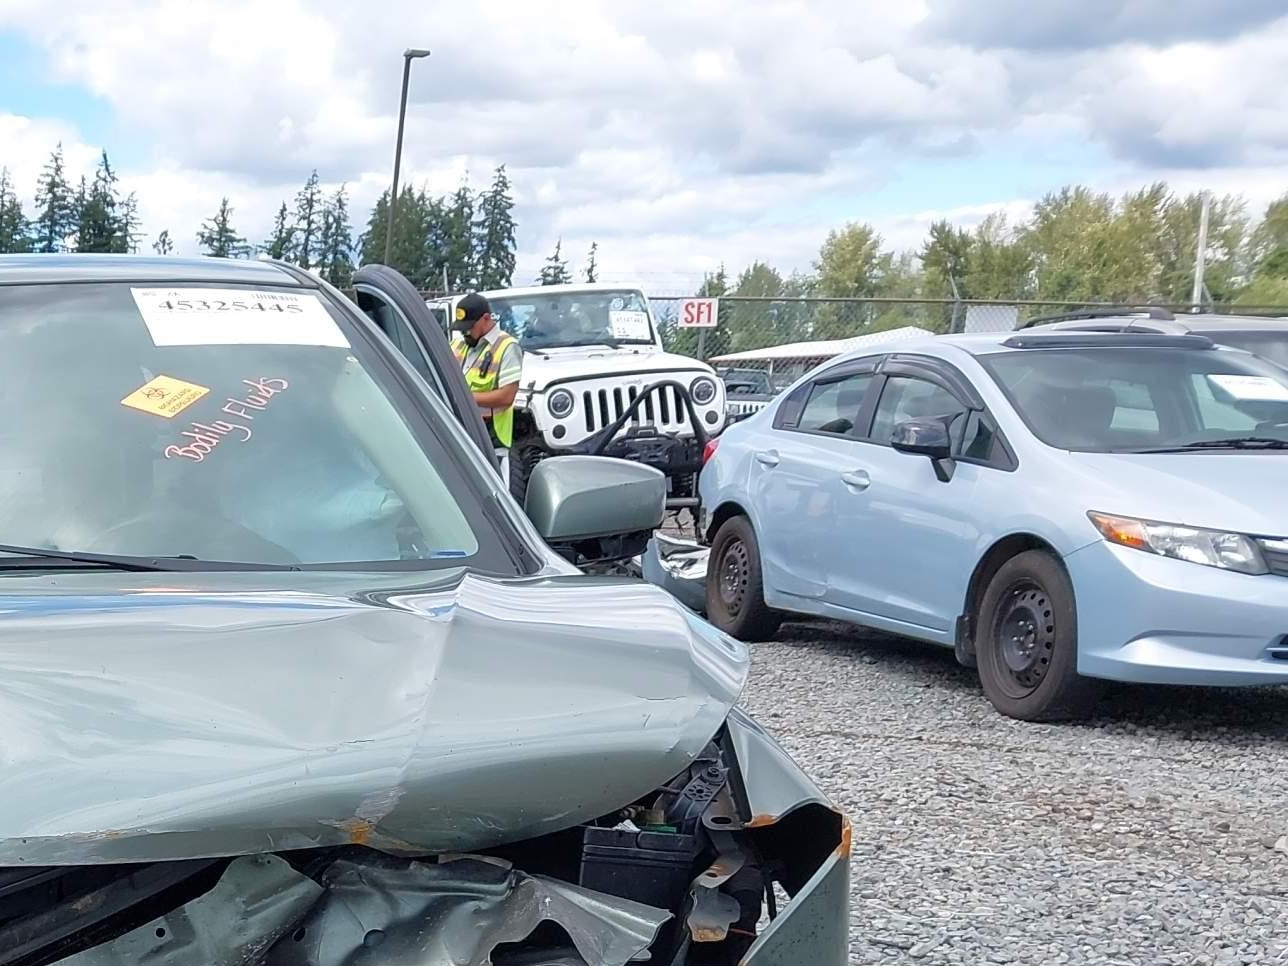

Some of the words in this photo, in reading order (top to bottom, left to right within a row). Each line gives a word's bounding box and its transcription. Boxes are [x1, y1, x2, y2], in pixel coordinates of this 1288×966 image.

[157, 299, 304, 314] 45325445
[684, 302, 713, 324] SF1
[165, 420, 251, 463] Bodily
[222, 377, 288, 420] Fluids
